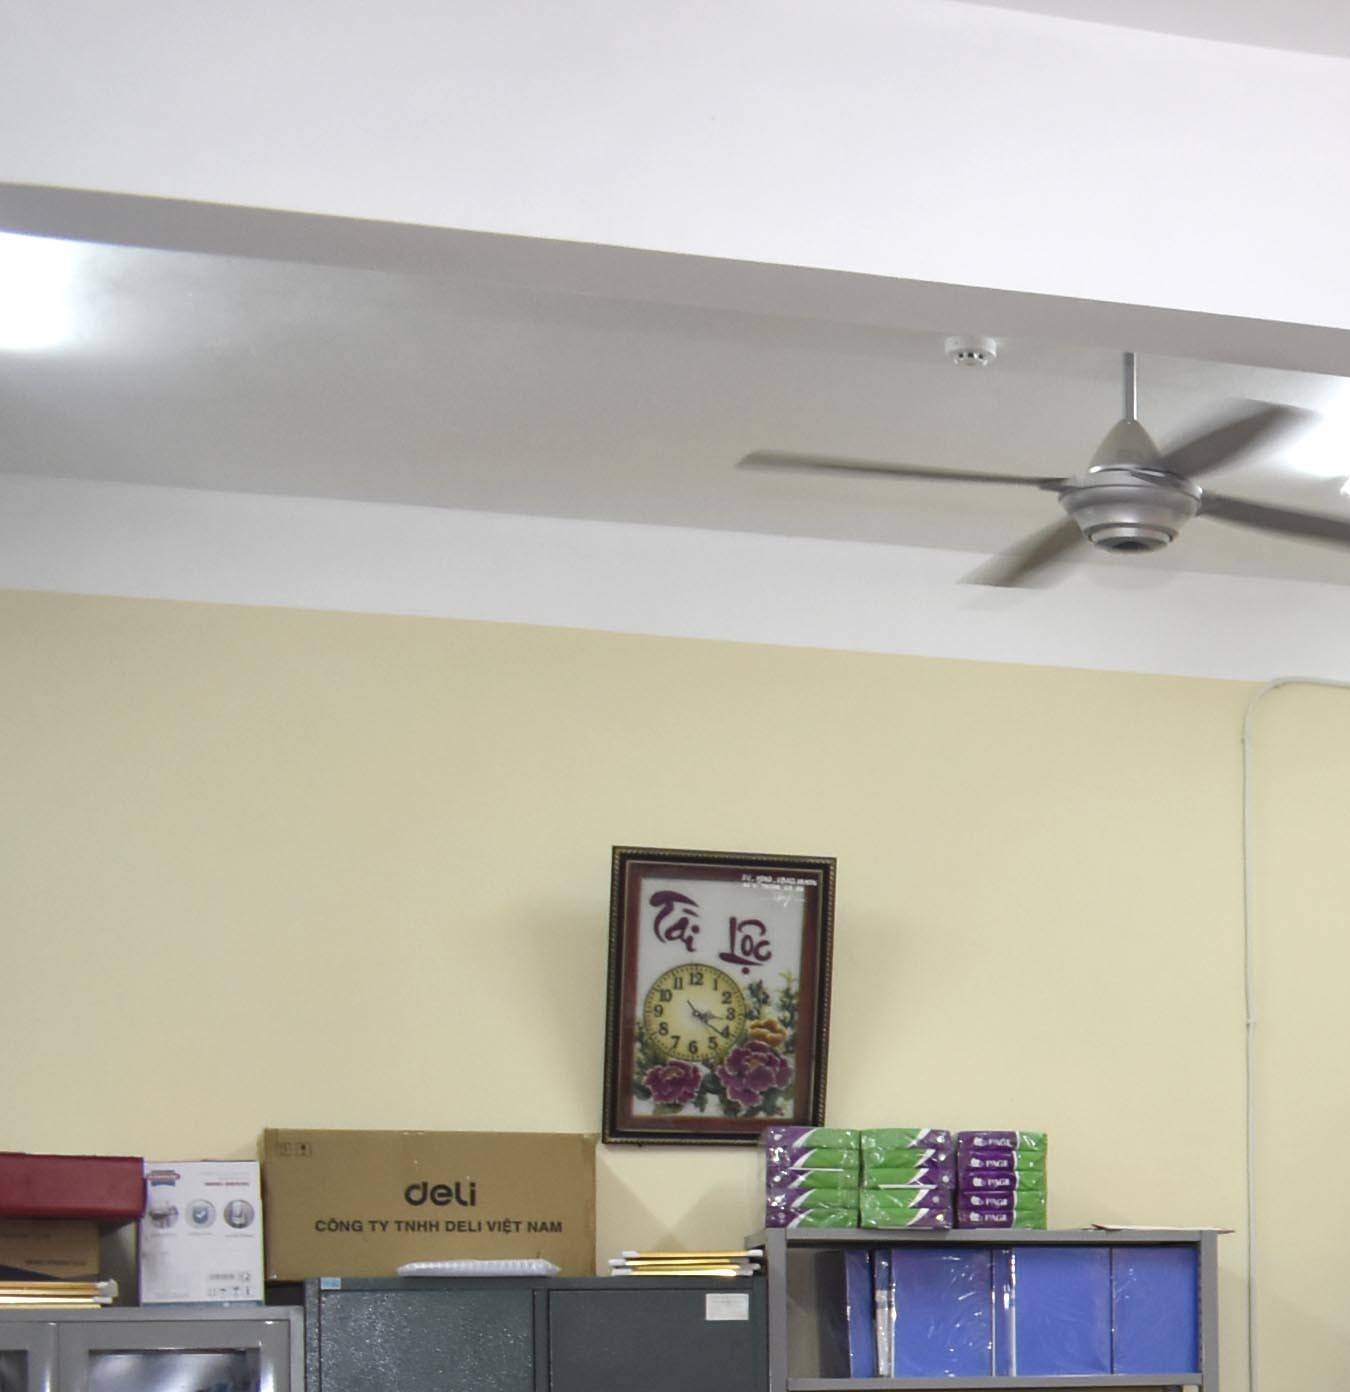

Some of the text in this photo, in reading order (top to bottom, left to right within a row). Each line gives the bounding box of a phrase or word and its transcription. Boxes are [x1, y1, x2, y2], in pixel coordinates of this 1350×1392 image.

[719, 916, 771, 974] Lộc
[689, 972, 703, 985] 12
[660, 989, 672, 1002] 10
[722, 991, 732, 1004] 2
[654, 1005, 663, 1018] 9
[727, 1007, 735, 1021] 3
[659, 1022, 669, 1036] 8
[671, 1036, 680, 1049] 7
[689, 1040, 698, 1053] 6
[708, 1037, 718, 1050] 5
[404, 1181, 476, 1206] deli
[315, 1218, 562, 1235] CÔNG TY TNHH DELI VIỆT NAM
